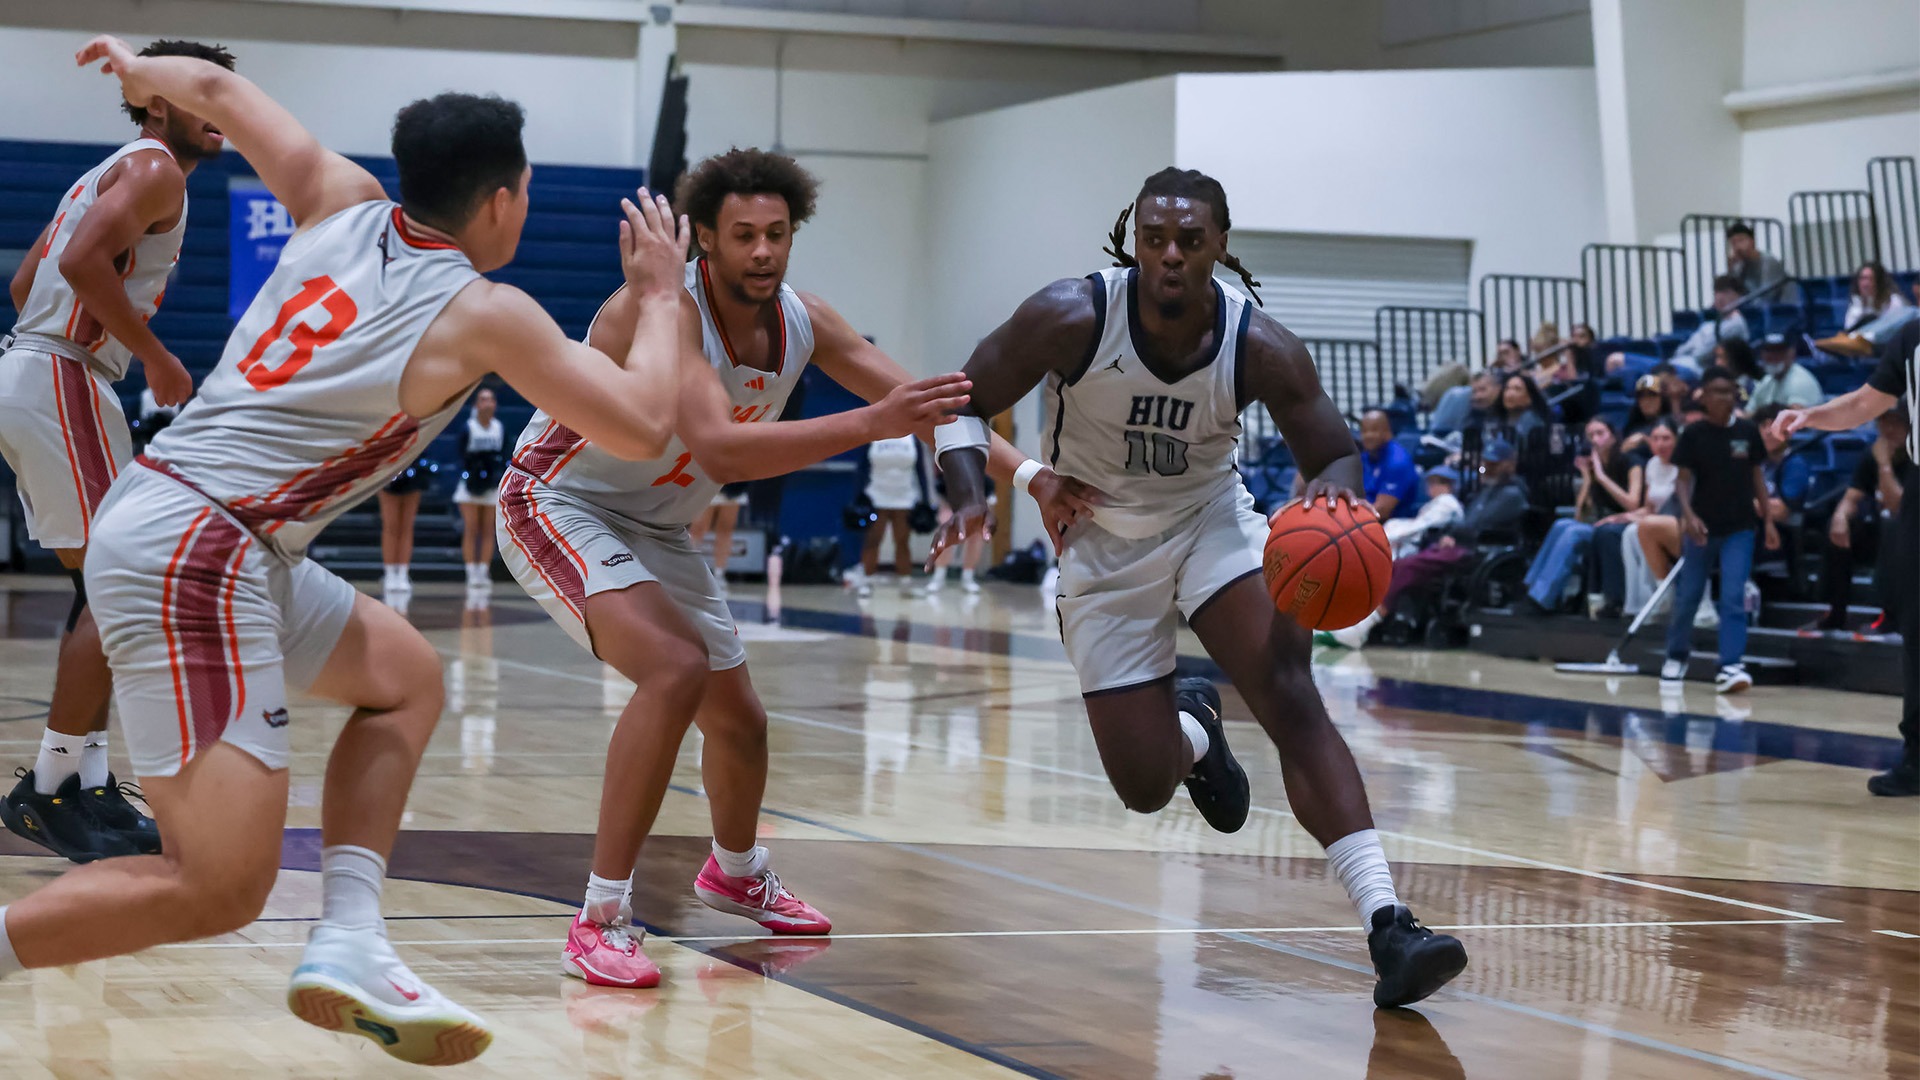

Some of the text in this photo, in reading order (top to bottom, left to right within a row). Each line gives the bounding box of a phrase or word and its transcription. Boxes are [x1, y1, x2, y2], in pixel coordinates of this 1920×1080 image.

[237, 274, 358, 392] 13
[1127, 395, 1194, 431] HIU
[1124, 430, 1189, 477] 10
